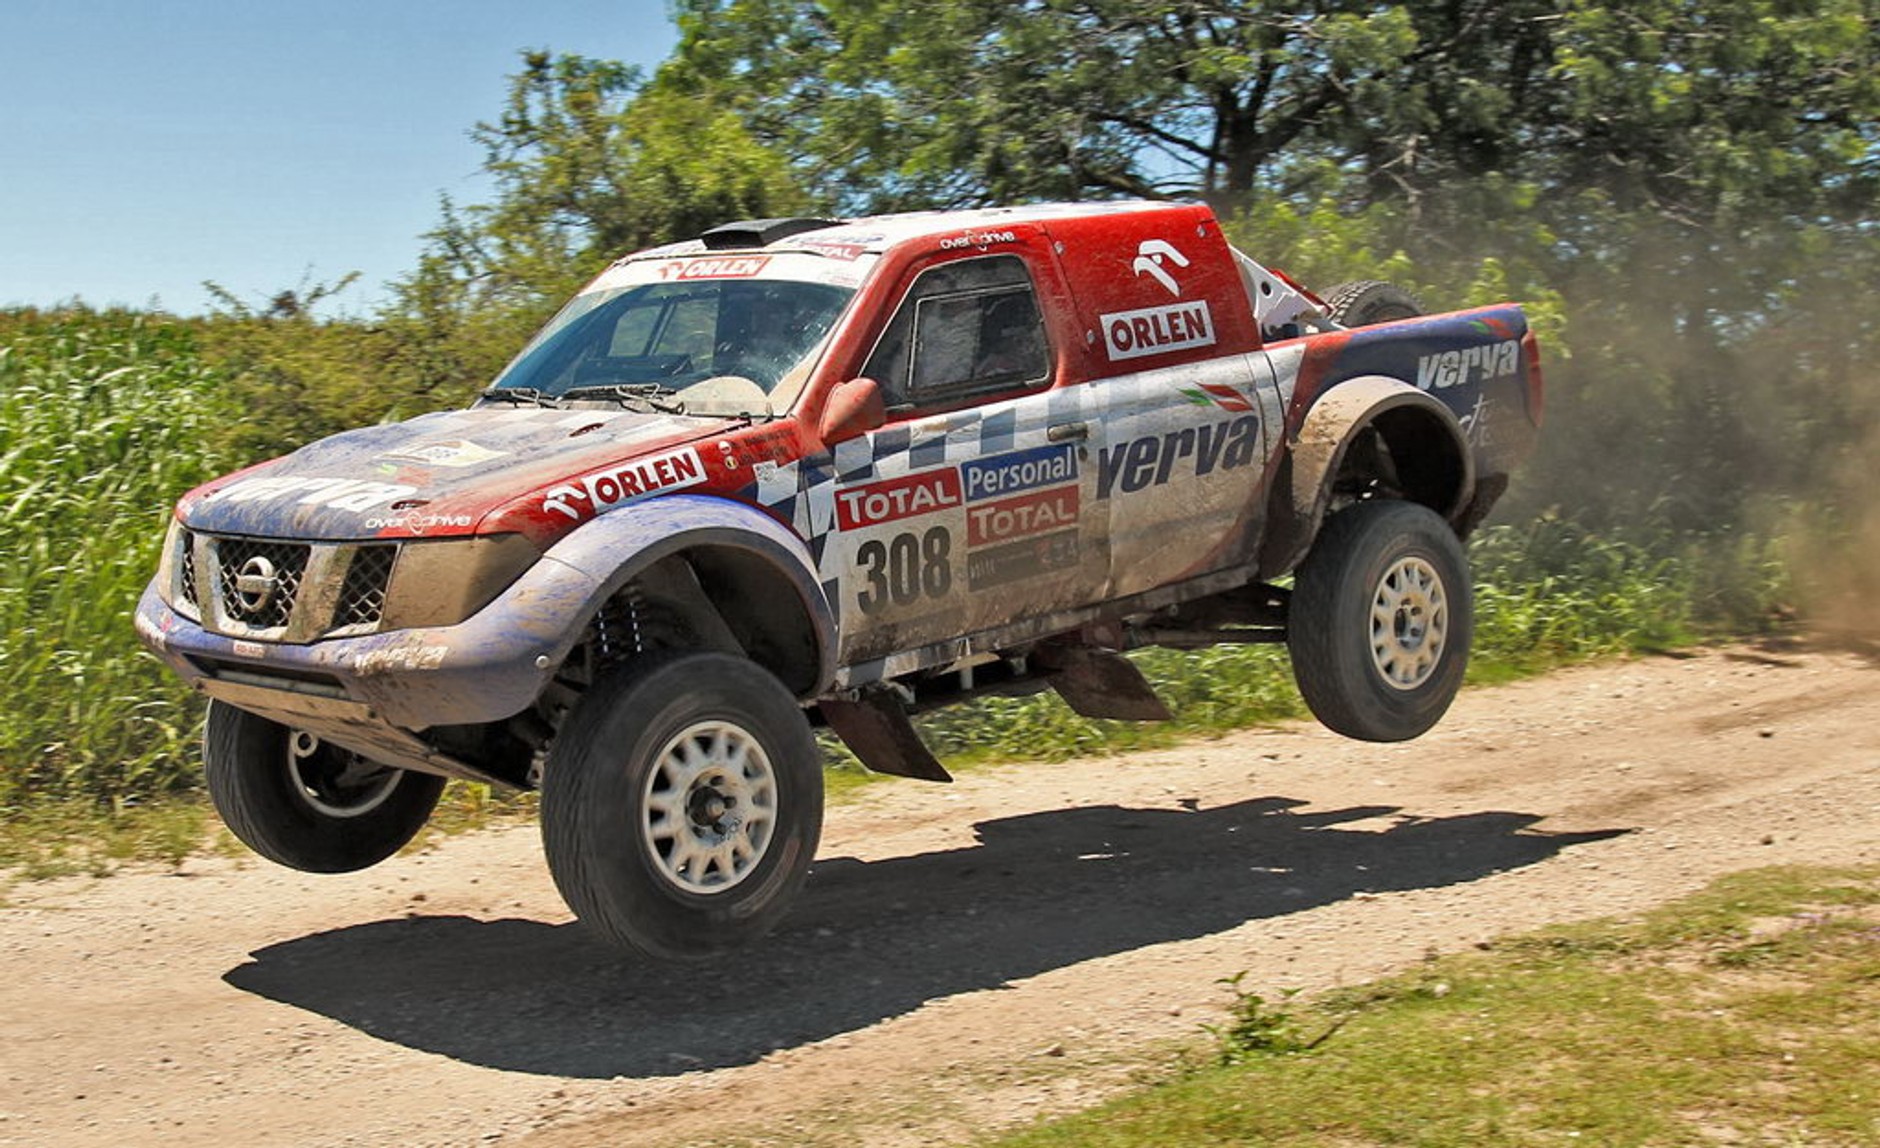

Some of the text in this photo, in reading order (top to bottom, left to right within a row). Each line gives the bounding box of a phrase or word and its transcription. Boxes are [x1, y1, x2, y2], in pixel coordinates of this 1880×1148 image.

[684, 259, 758, 277] ORLEN
[1110, 308, 1207, 352] ORLEN
[594, 452, 698, 504] ORLEN
[967, 453, 1074, 497] Personal
[839, 479, 958, 525] TOTAL
[970, 497, 1077, 539] TOTAL
[856, 525, 951, 616] 308
